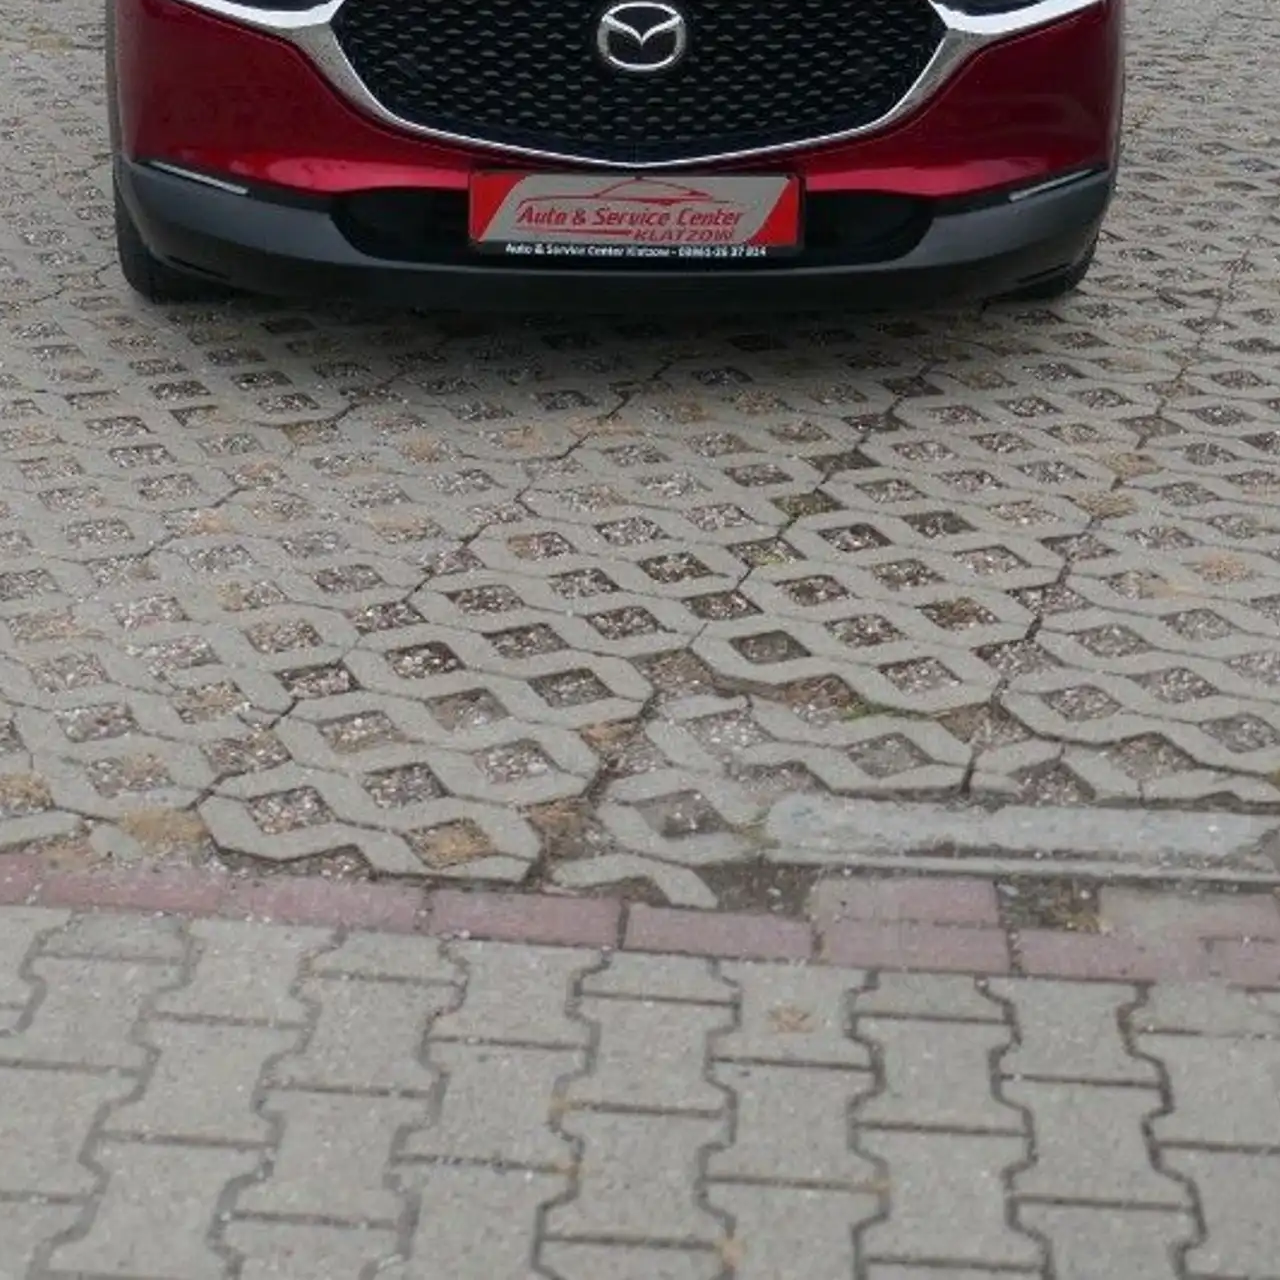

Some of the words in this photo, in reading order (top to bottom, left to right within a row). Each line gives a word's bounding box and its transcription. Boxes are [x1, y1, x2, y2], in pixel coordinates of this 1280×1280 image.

[517, 205, 567, 226] Auto
[571, 206, 587, 226] &
[591, 205, 671, 227] Service
[676, 206, 747, 227] Center
[632, 228, 735, 242] KLATZOW
